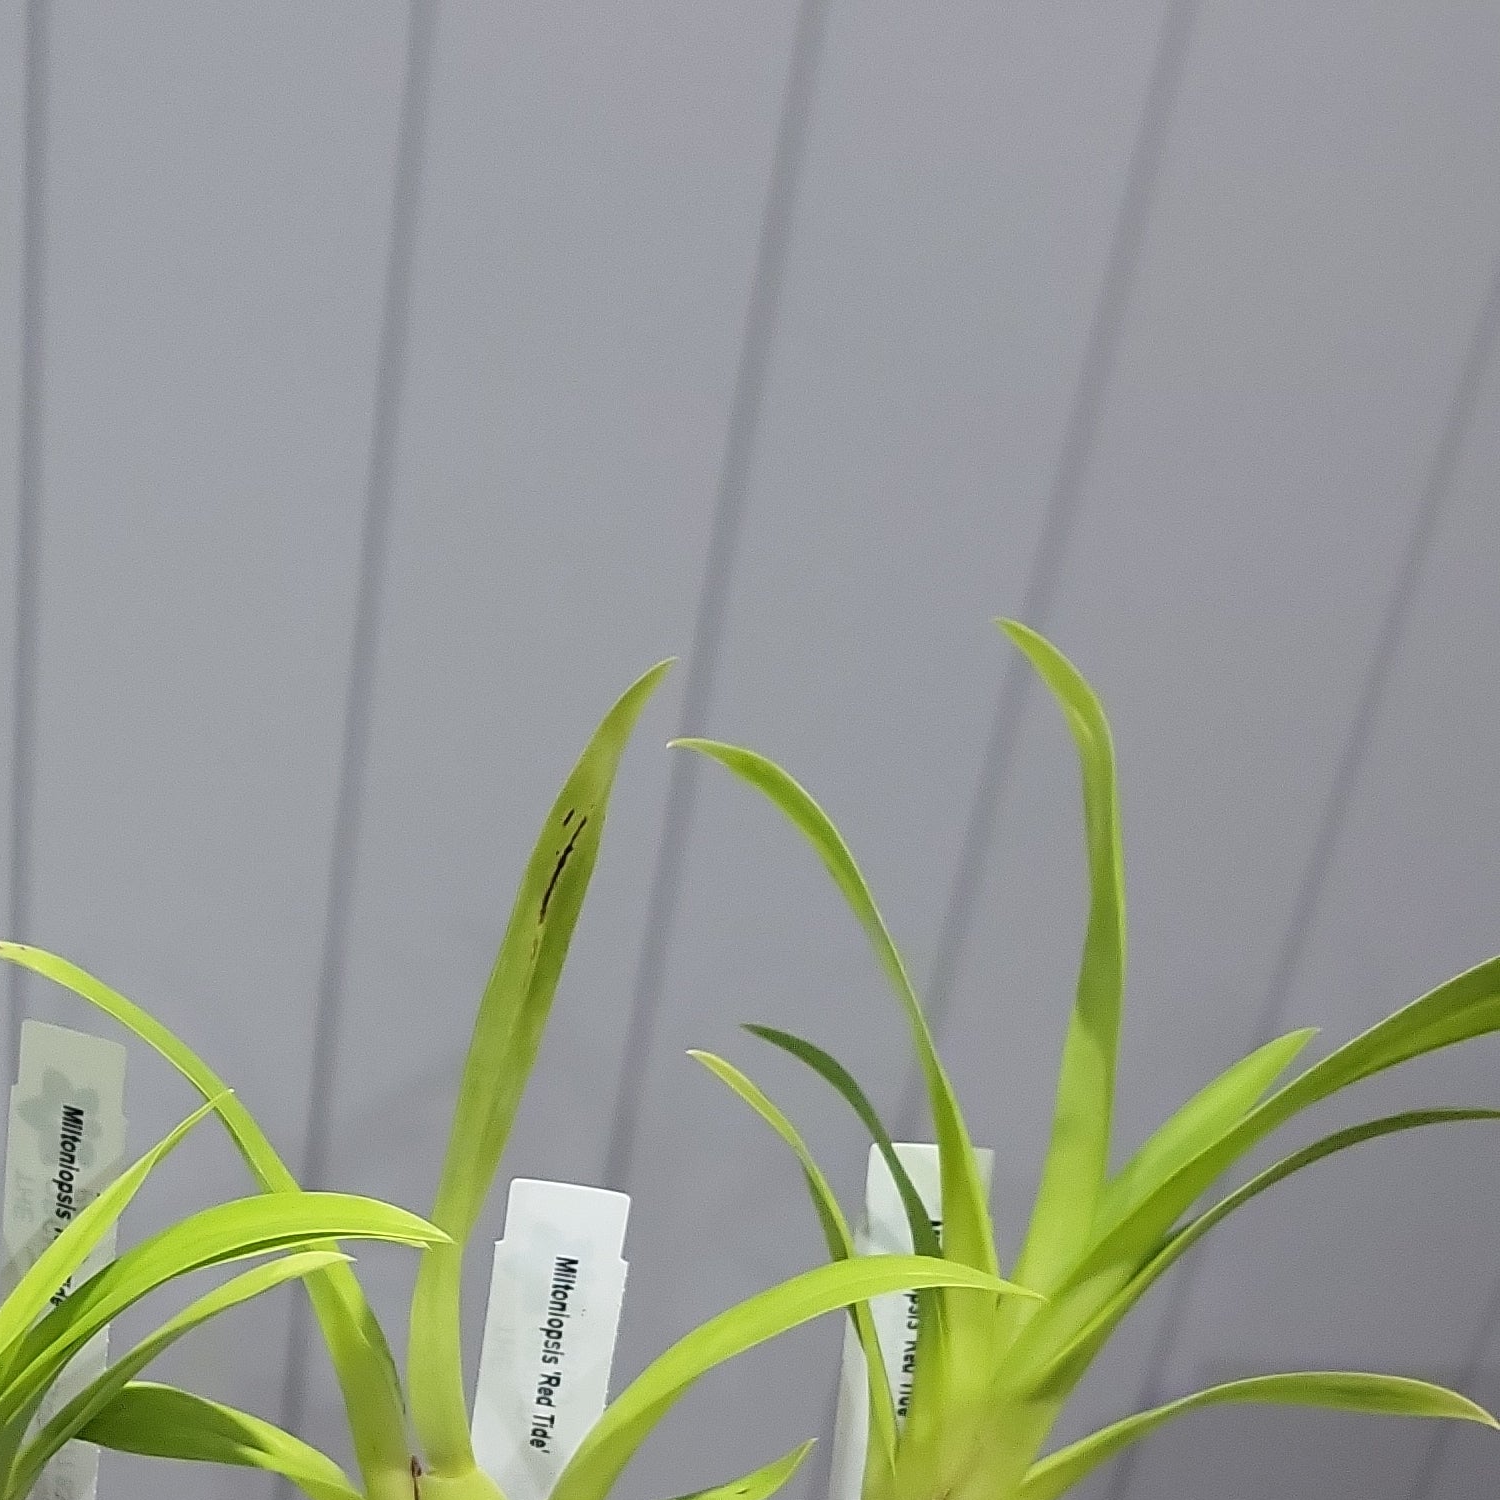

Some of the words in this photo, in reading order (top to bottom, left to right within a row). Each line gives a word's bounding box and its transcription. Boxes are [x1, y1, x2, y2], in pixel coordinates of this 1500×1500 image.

[52, 1104, 84, 1220] Miltoniopsis
[539, 1256, 579, 1365] Miltoniopsis
[535, 1371, 562, 1408] 'Red
[529, 1414, 555, 1454] Tide'
